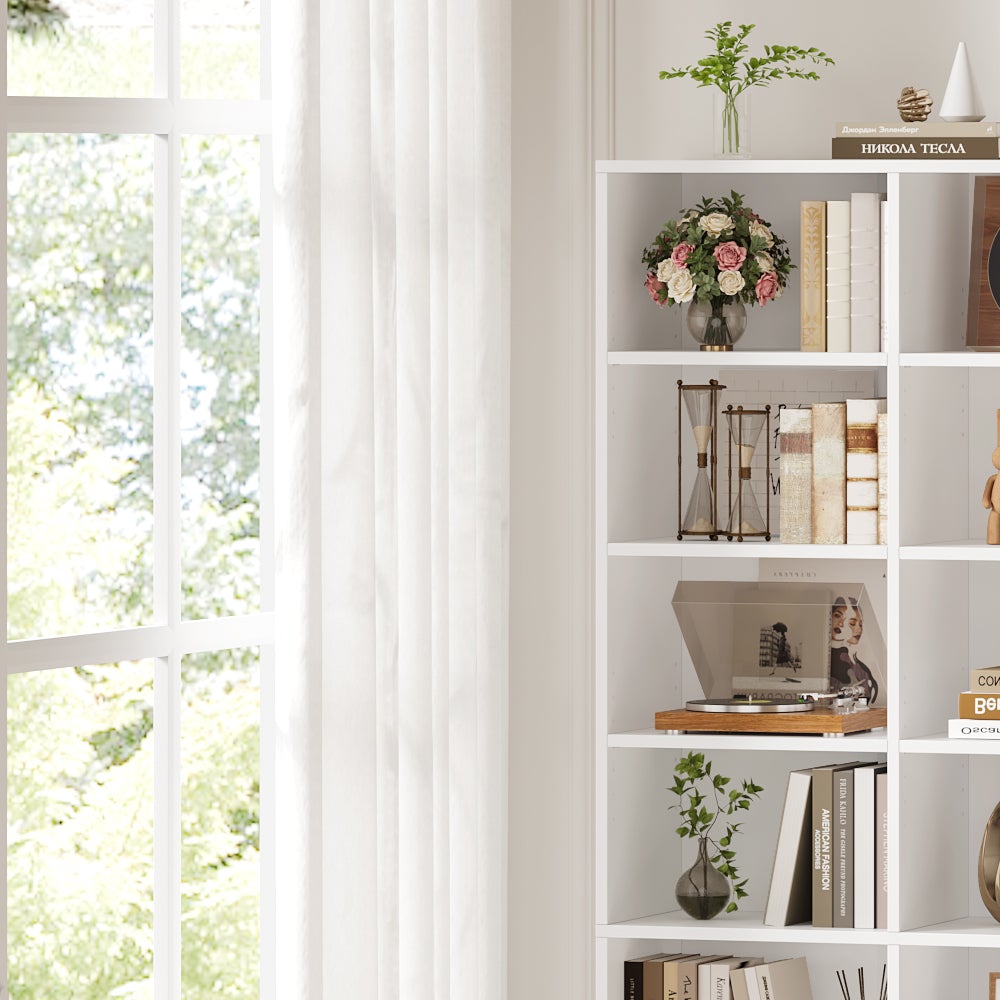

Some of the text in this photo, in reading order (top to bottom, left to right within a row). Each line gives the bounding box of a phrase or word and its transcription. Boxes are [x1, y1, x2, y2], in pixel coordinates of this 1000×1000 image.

[861, 143, 966, 154] НИКОЛА ТЕСЛА
[839, 778, 847, 799] FRIDA
[839, 800, 847, 826] KAHLO
[821, 809, 831, 891] AMERICAN FASHION
[716, 977, 726, 1000] Karen
